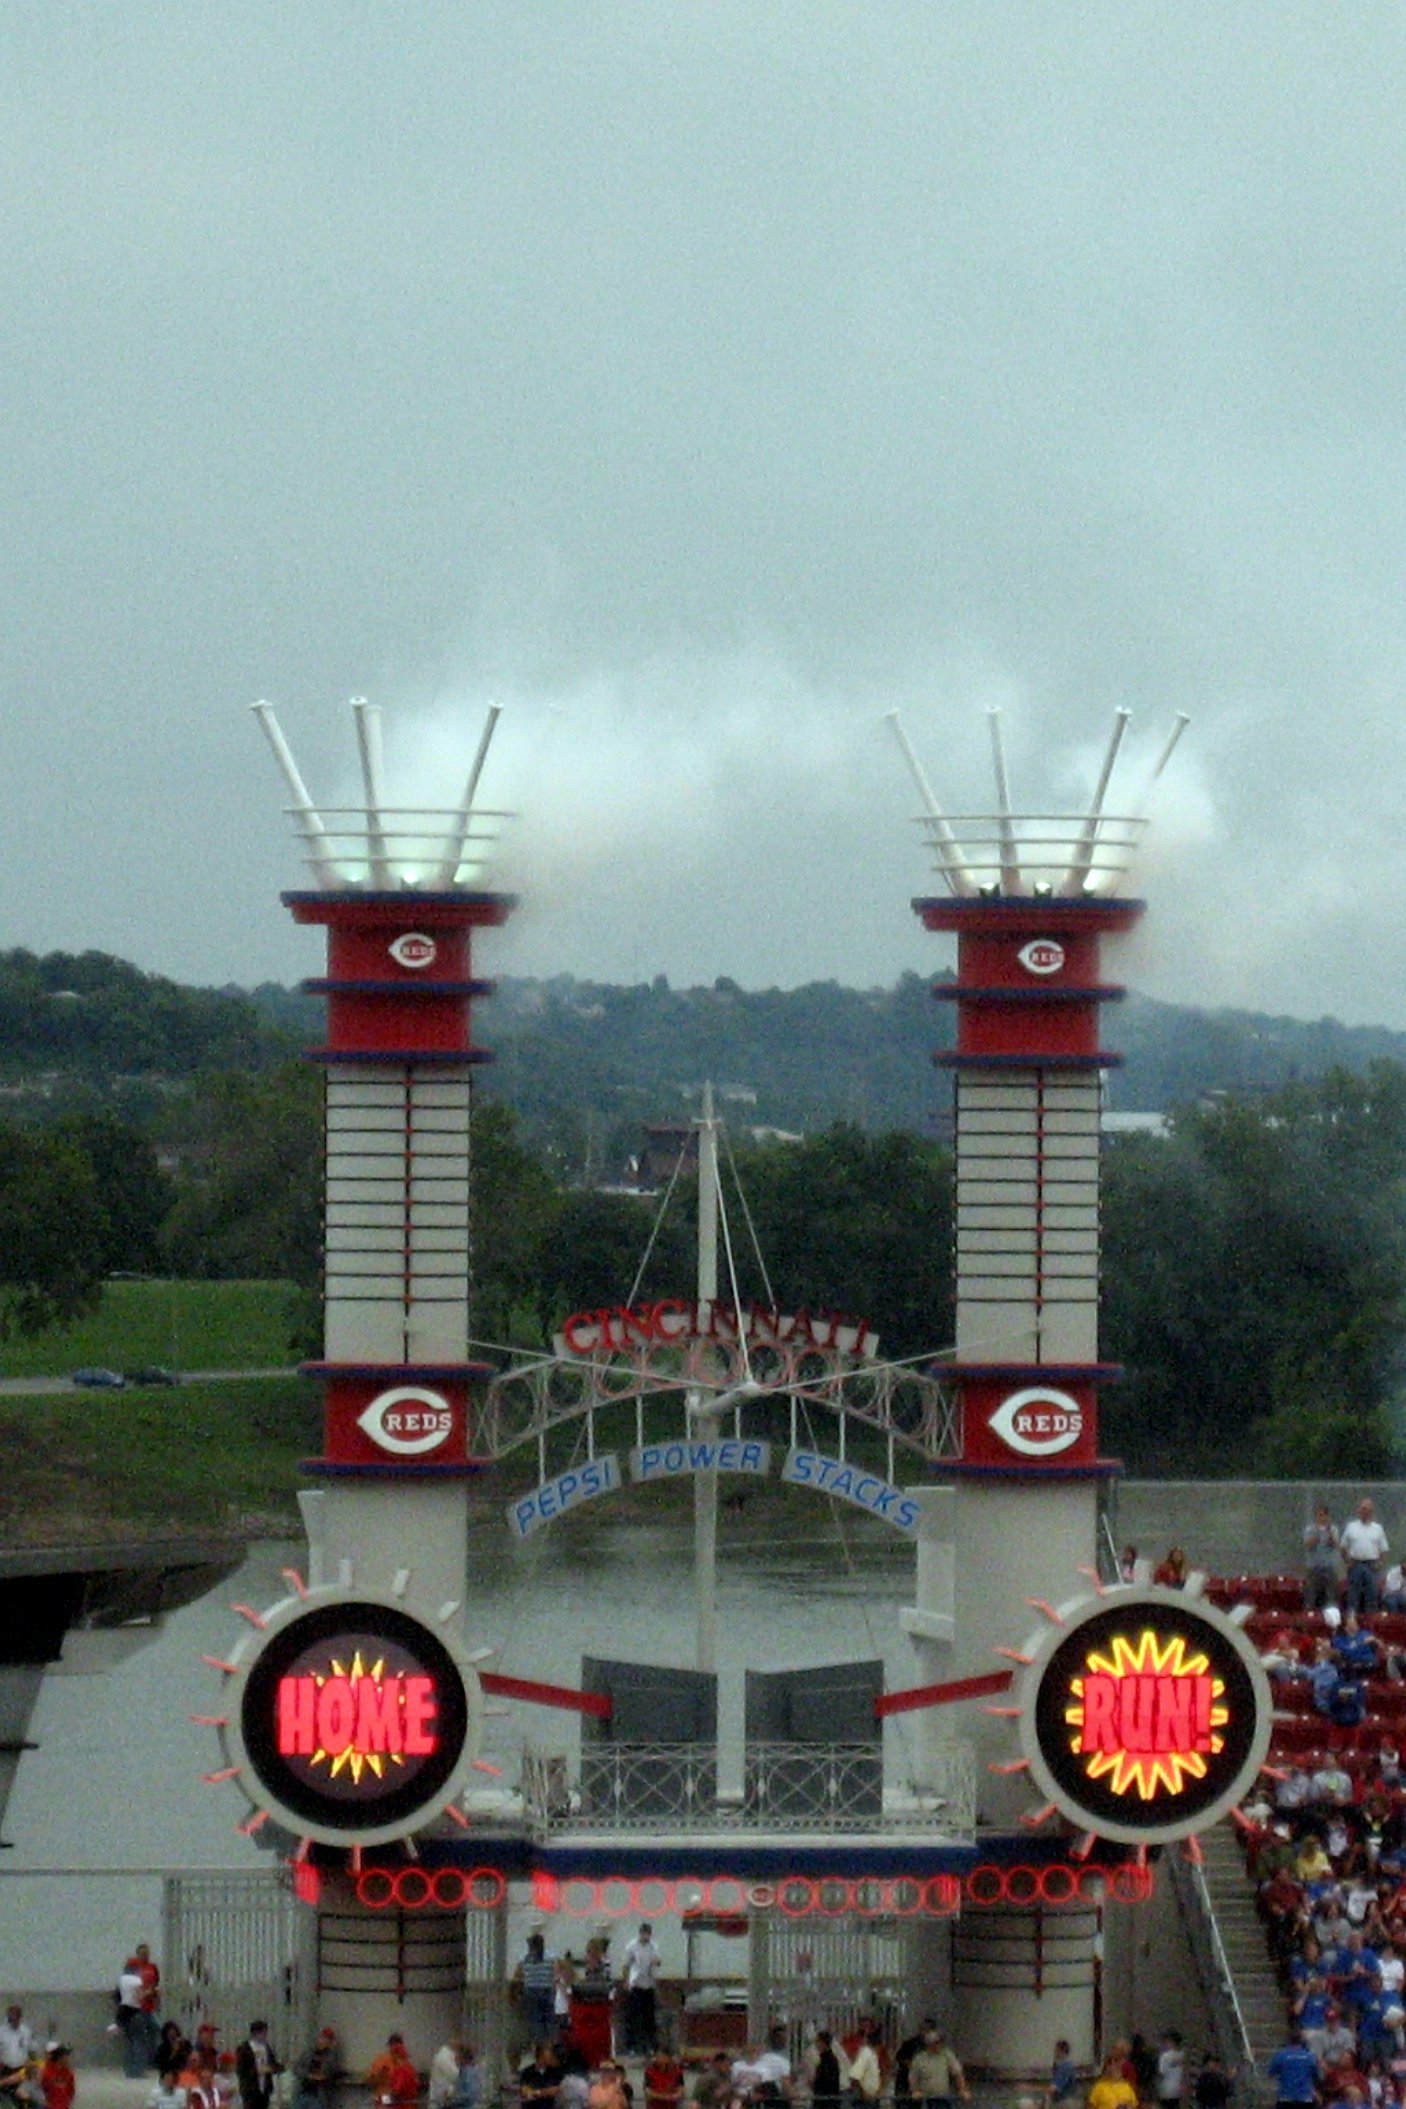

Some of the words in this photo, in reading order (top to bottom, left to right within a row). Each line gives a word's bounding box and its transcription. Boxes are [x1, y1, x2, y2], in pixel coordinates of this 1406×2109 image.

[562, 1298, 873, 1355] CINCINNATI
[386, 1412, 452, 1431] REDS
[1017, 1414, 1083, 1433] REDS
[515, 1465, 617, 1537] PEPSI
[640, 1442, 765, 1476] POWER
[794, 1454, 922, 1529] STACKS
[278, 1677, 438, 1755] HOME
[1082, 1674, 1213, 1753] RUN!
